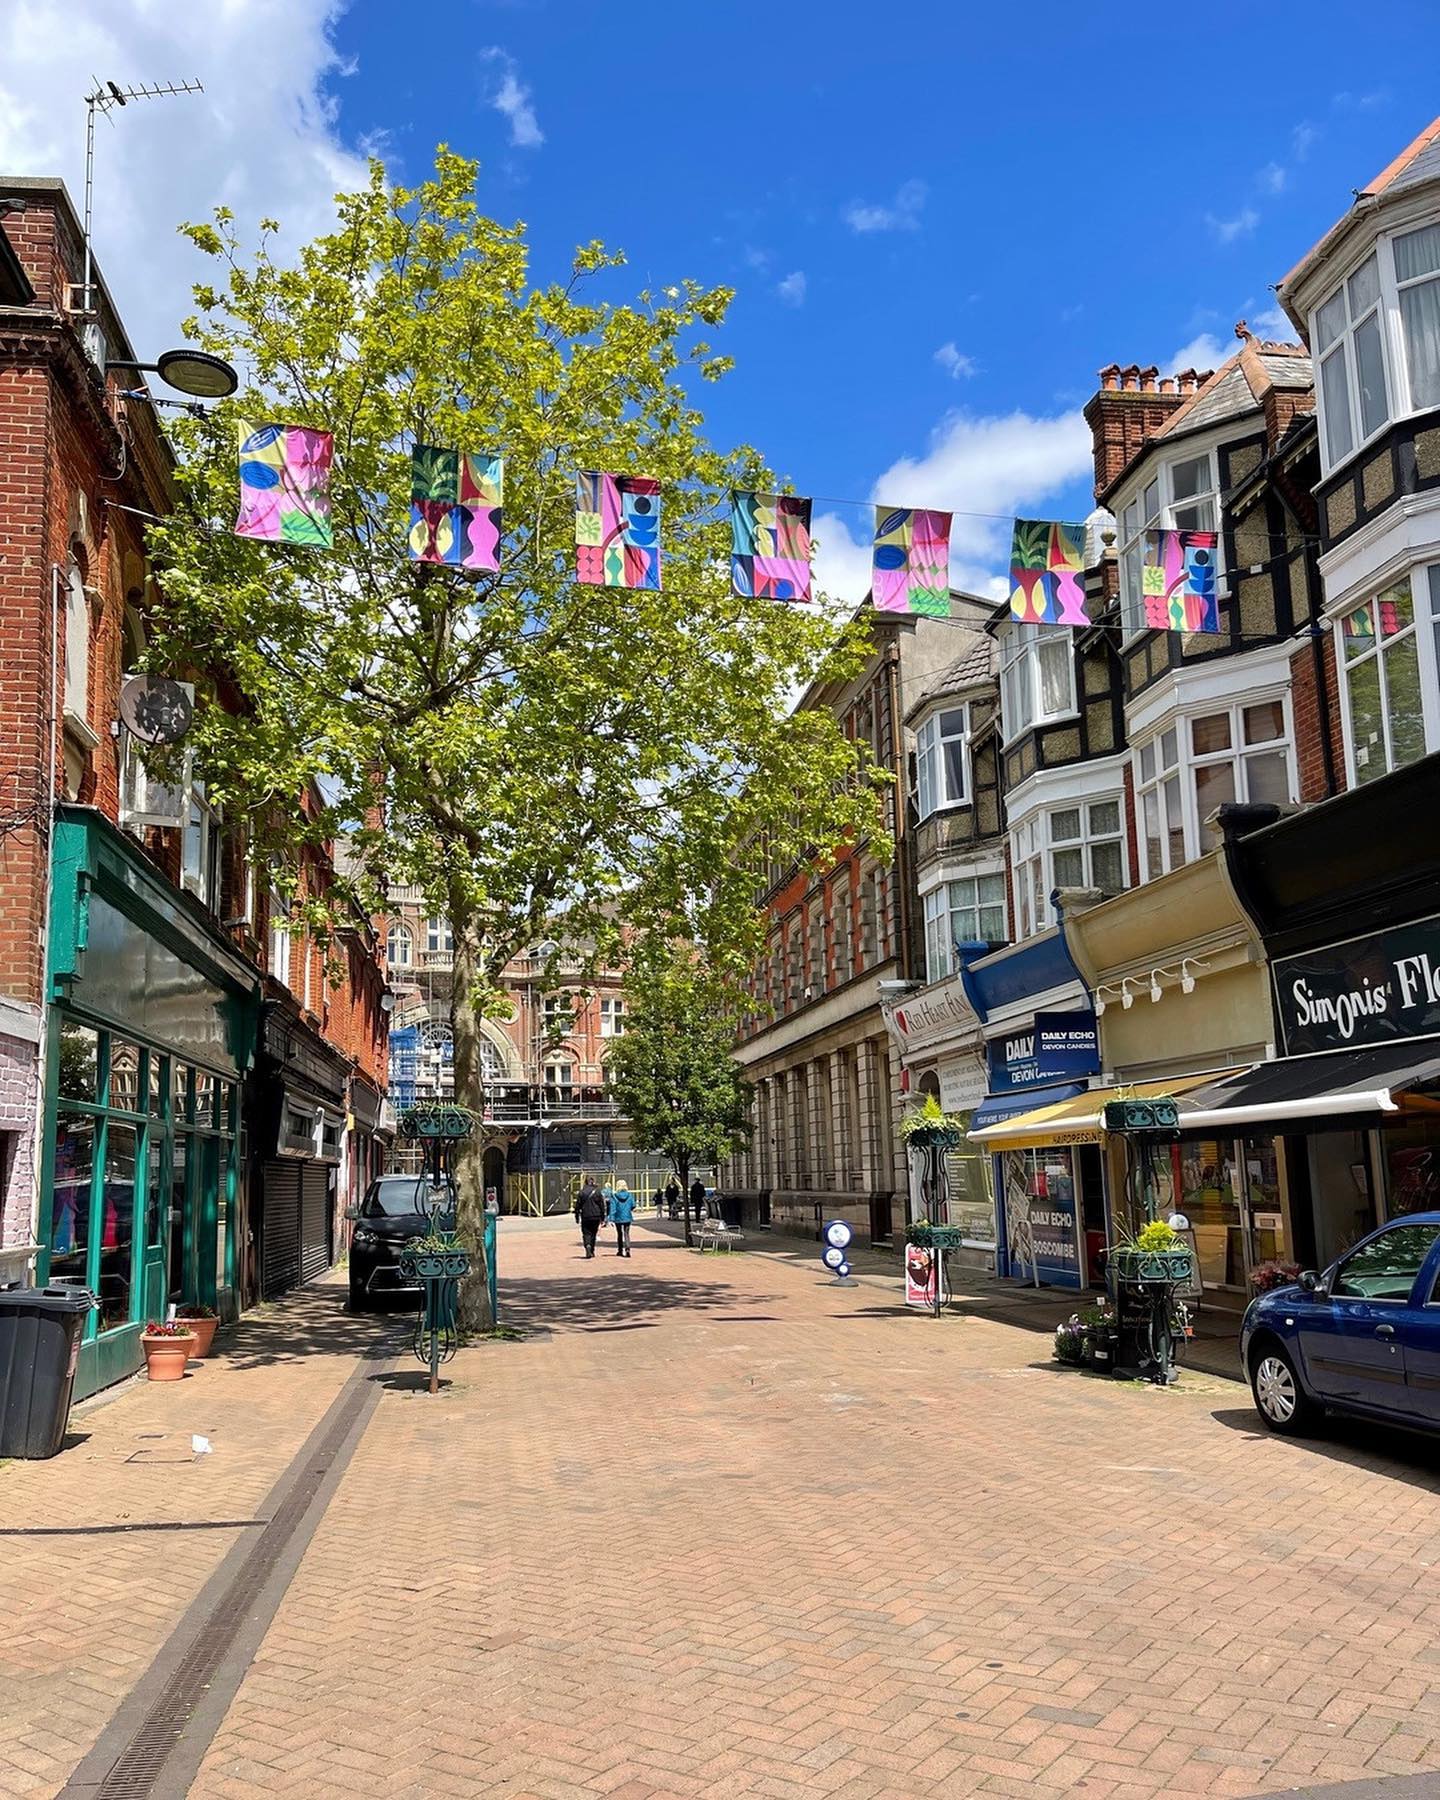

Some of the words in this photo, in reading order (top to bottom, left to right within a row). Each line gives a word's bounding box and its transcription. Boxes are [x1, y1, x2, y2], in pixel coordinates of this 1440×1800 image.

[1041, 1032, 1067, 1040] DAILY
[1069, 1031, 1095, 1040] ECHO
[1005, 1035, 1035, 1061] DAILY
[1011, 1068, 1035, 1083] DEVON
[1030, 1211, 1050, 1225] DAILY
[1051, 1212, 1072, 1228] ECHO
[1033, 1240, 1075, 1259] BOSCOMBE
